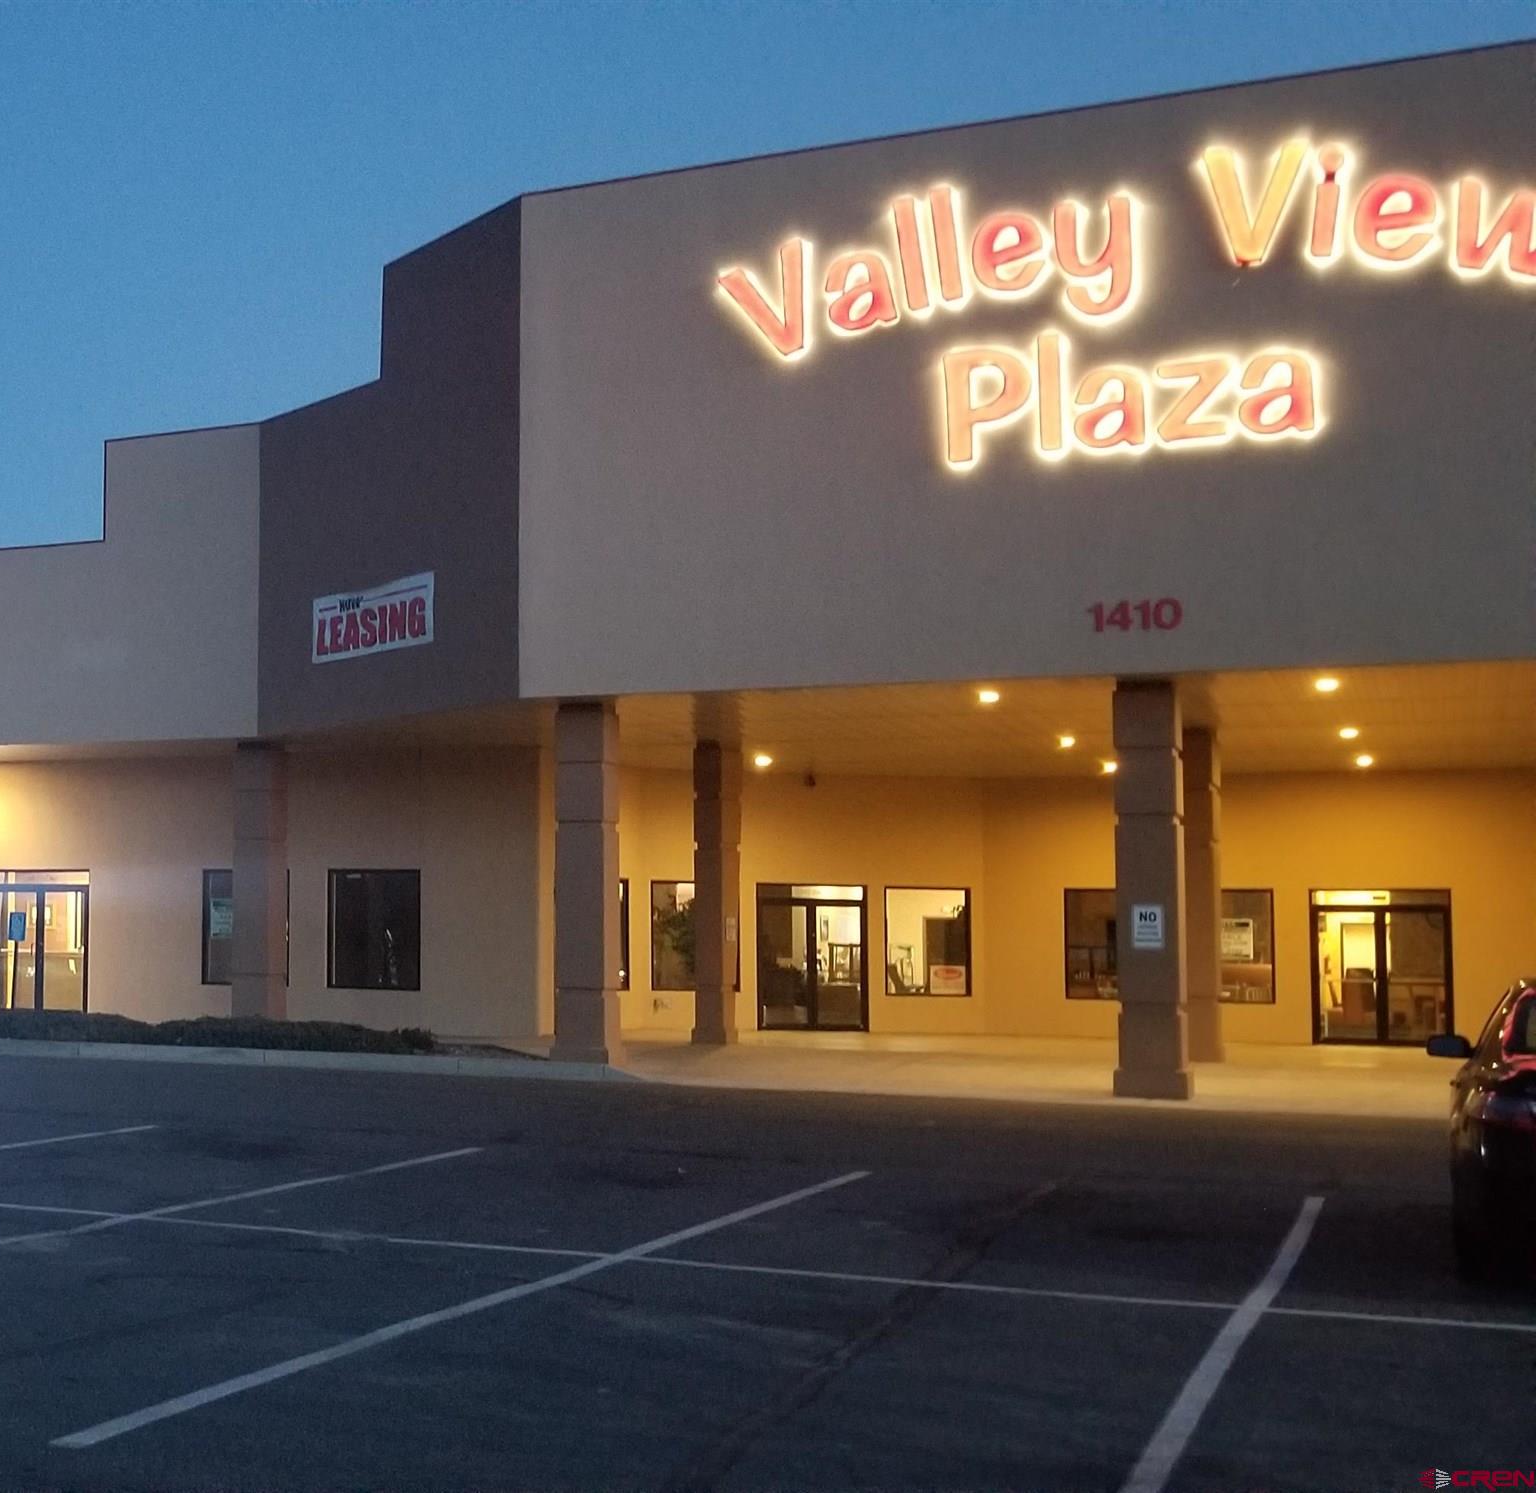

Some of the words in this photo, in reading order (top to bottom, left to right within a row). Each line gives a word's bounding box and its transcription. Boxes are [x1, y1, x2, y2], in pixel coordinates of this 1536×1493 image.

[716, 184, 1138, 360] Valley
[940, 330, 1320, 470] Plaza
[316, 597, 427, 656] LEASING
[1087, 597, 1184, 633] 1410
[1139, 911, 1157, 922] NO
